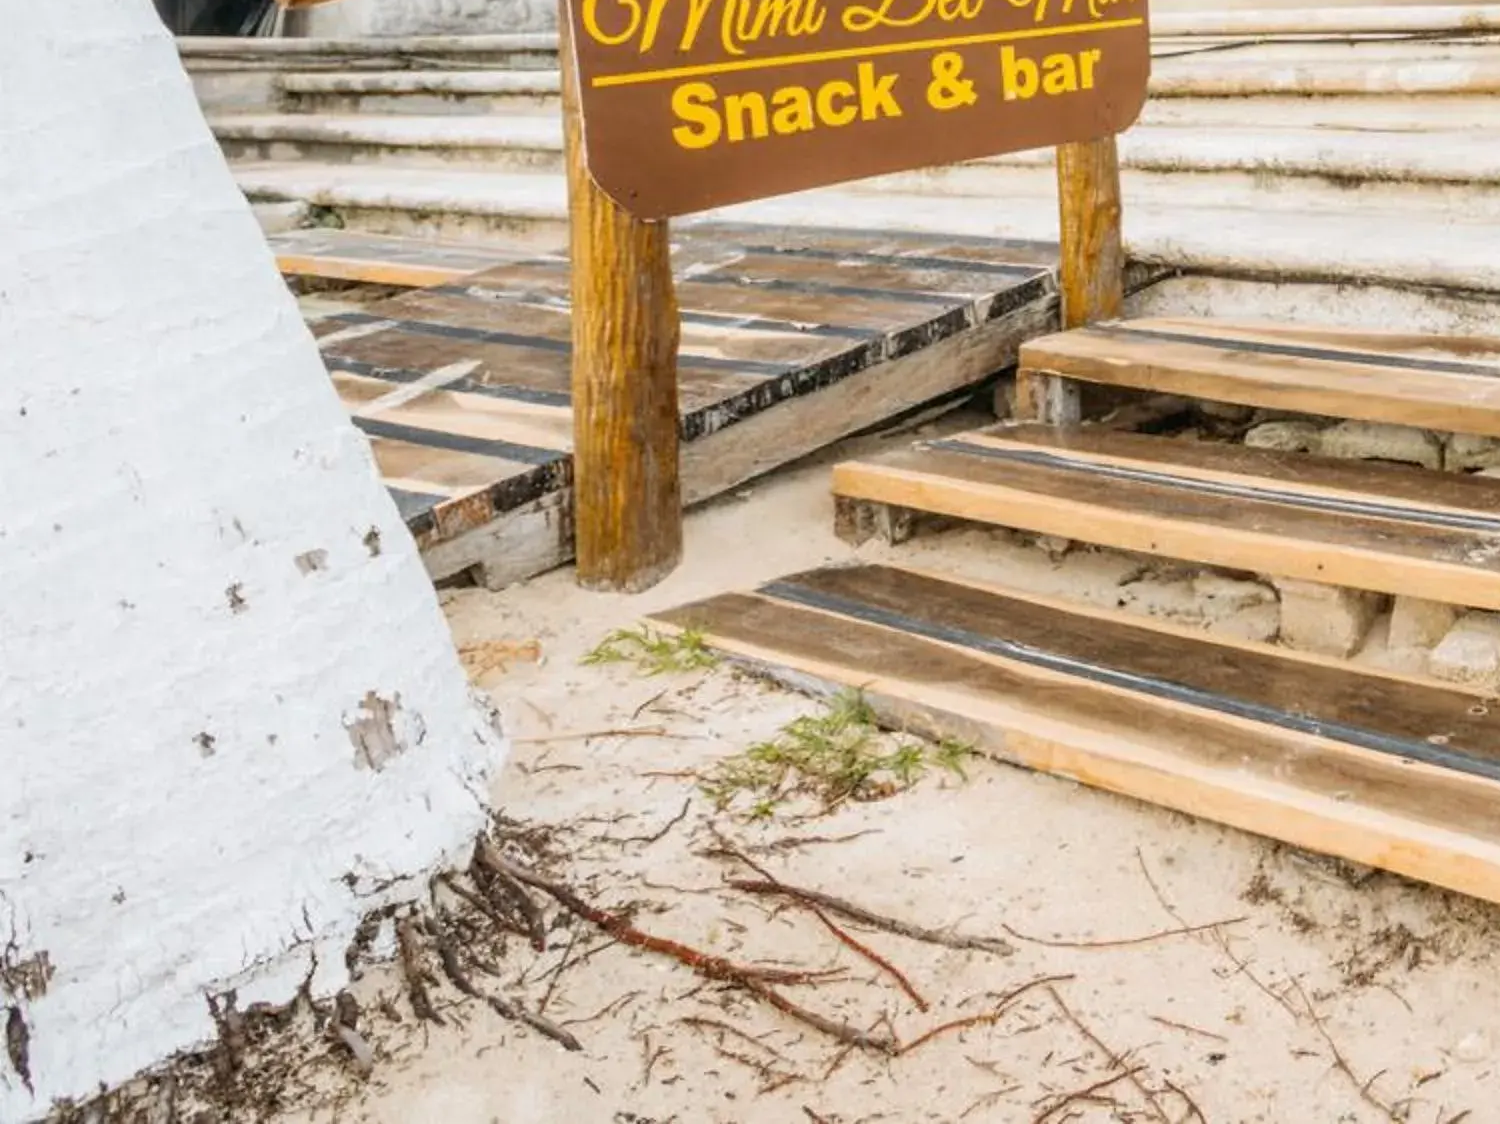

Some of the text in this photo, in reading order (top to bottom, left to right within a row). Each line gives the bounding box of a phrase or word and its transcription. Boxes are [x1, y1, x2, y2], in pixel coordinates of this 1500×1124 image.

[671, 45, 1102, 149] Snack & bar
